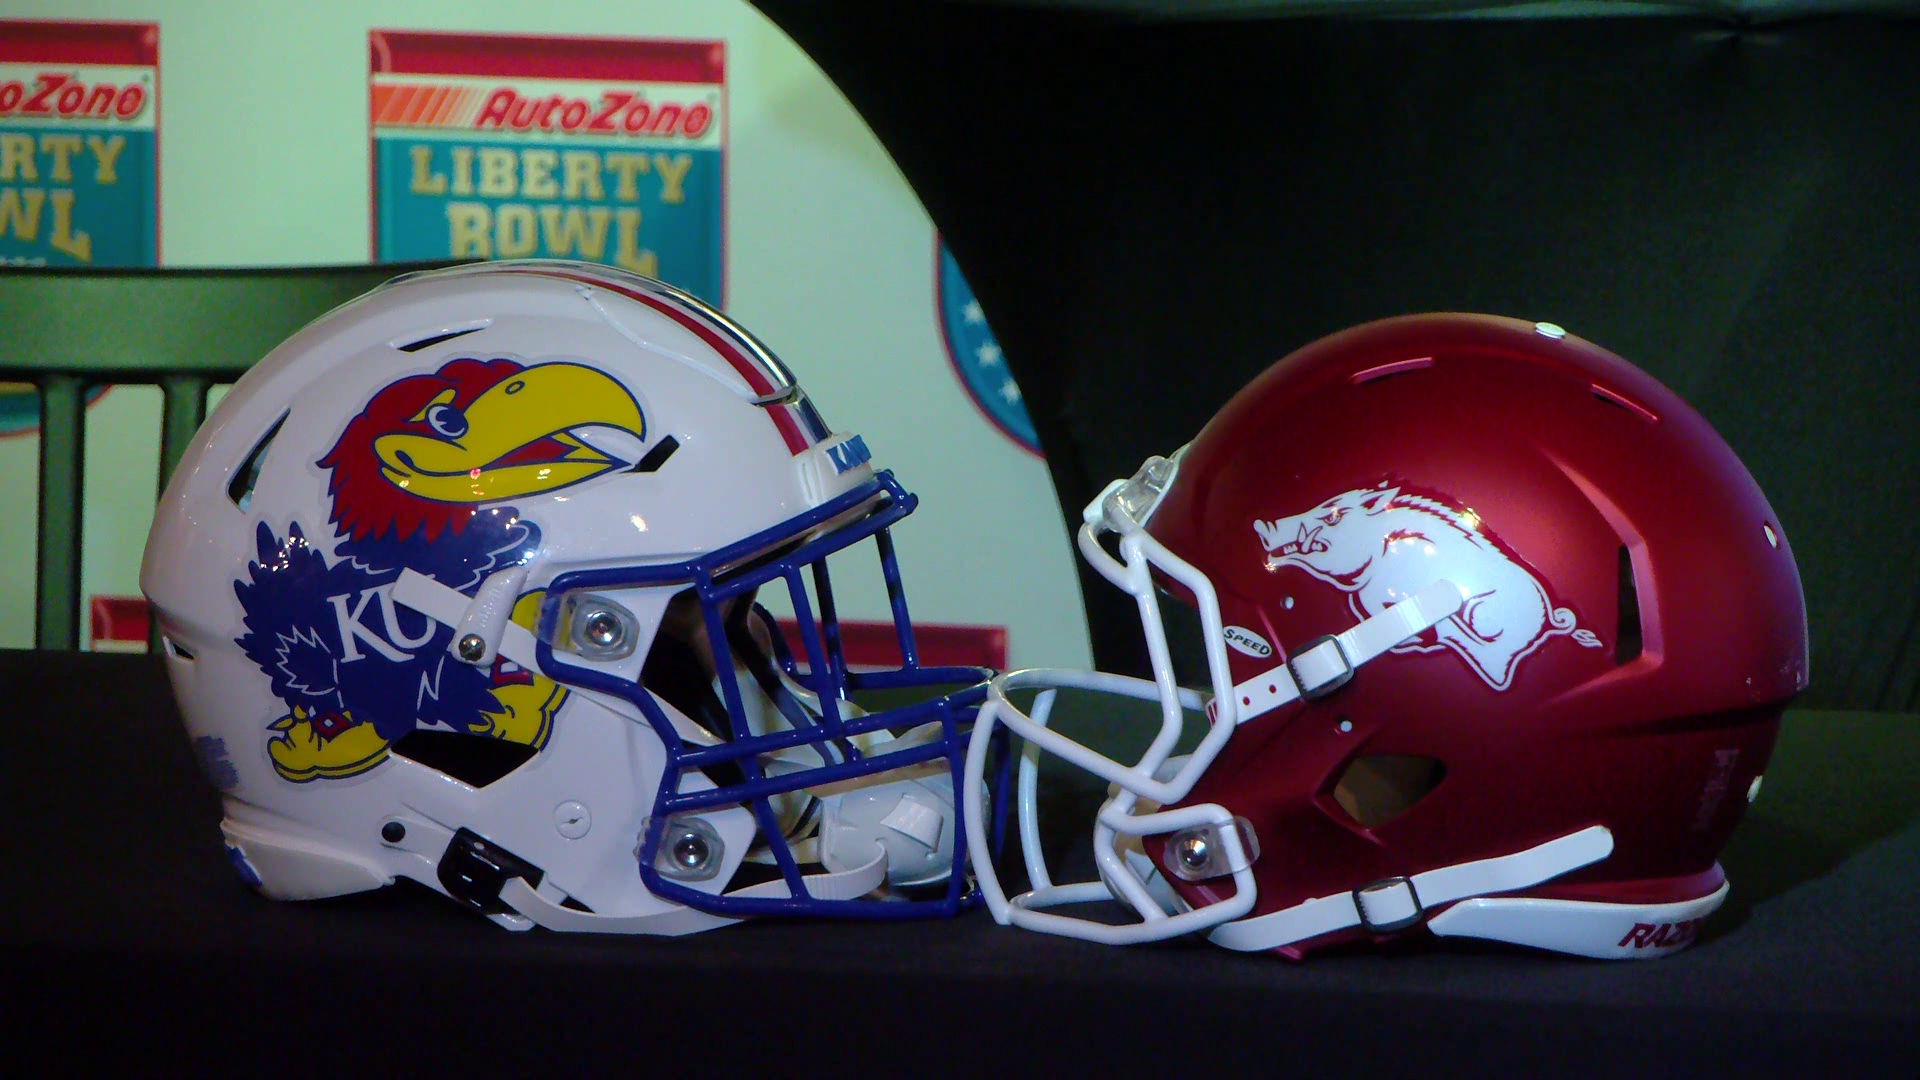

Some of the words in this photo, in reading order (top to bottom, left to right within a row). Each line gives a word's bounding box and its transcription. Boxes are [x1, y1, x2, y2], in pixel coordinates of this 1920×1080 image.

[473, 87, 713, 138] AutoZone
[409, 146, 693, 204] LIBERTY
[445, 202, 660, 279] BOWL
[326, 573, 437, 663] KU
[1223, 628, 1271, 656] SPEED
